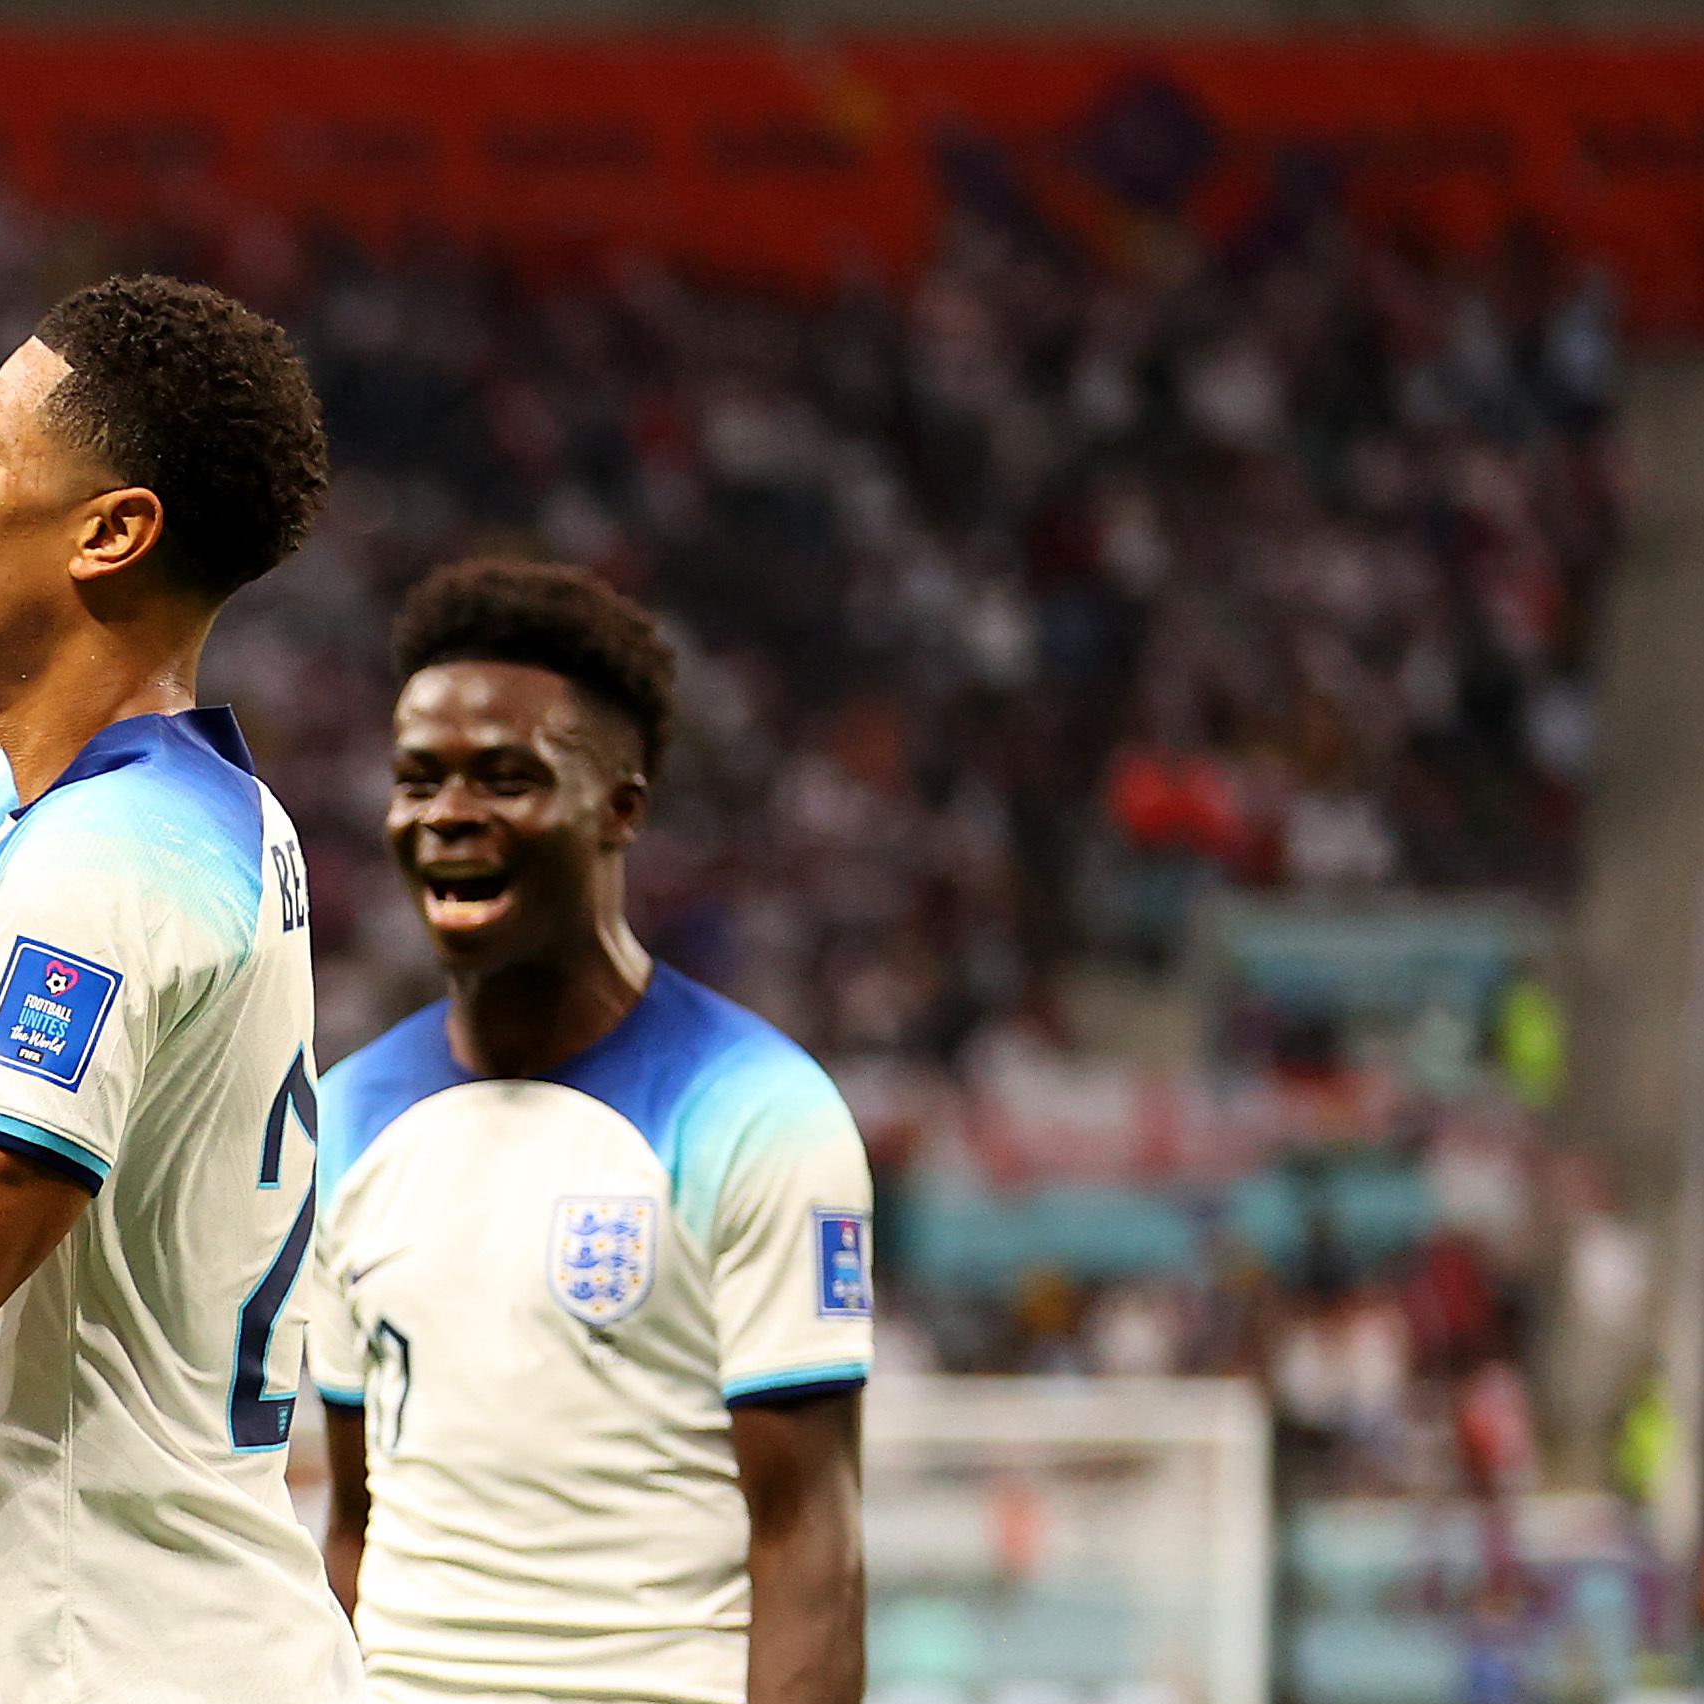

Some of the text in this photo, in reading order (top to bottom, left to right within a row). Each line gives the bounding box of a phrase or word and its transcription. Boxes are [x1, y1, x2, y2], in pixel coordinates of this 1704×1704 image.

[18, 1007, 69, 1038] UNITES
[23, 993, 73, 1023] FOOTBALL
[10, 1025, 66, 1056] the World
[18, 1047, 43, 1063] FIFA
